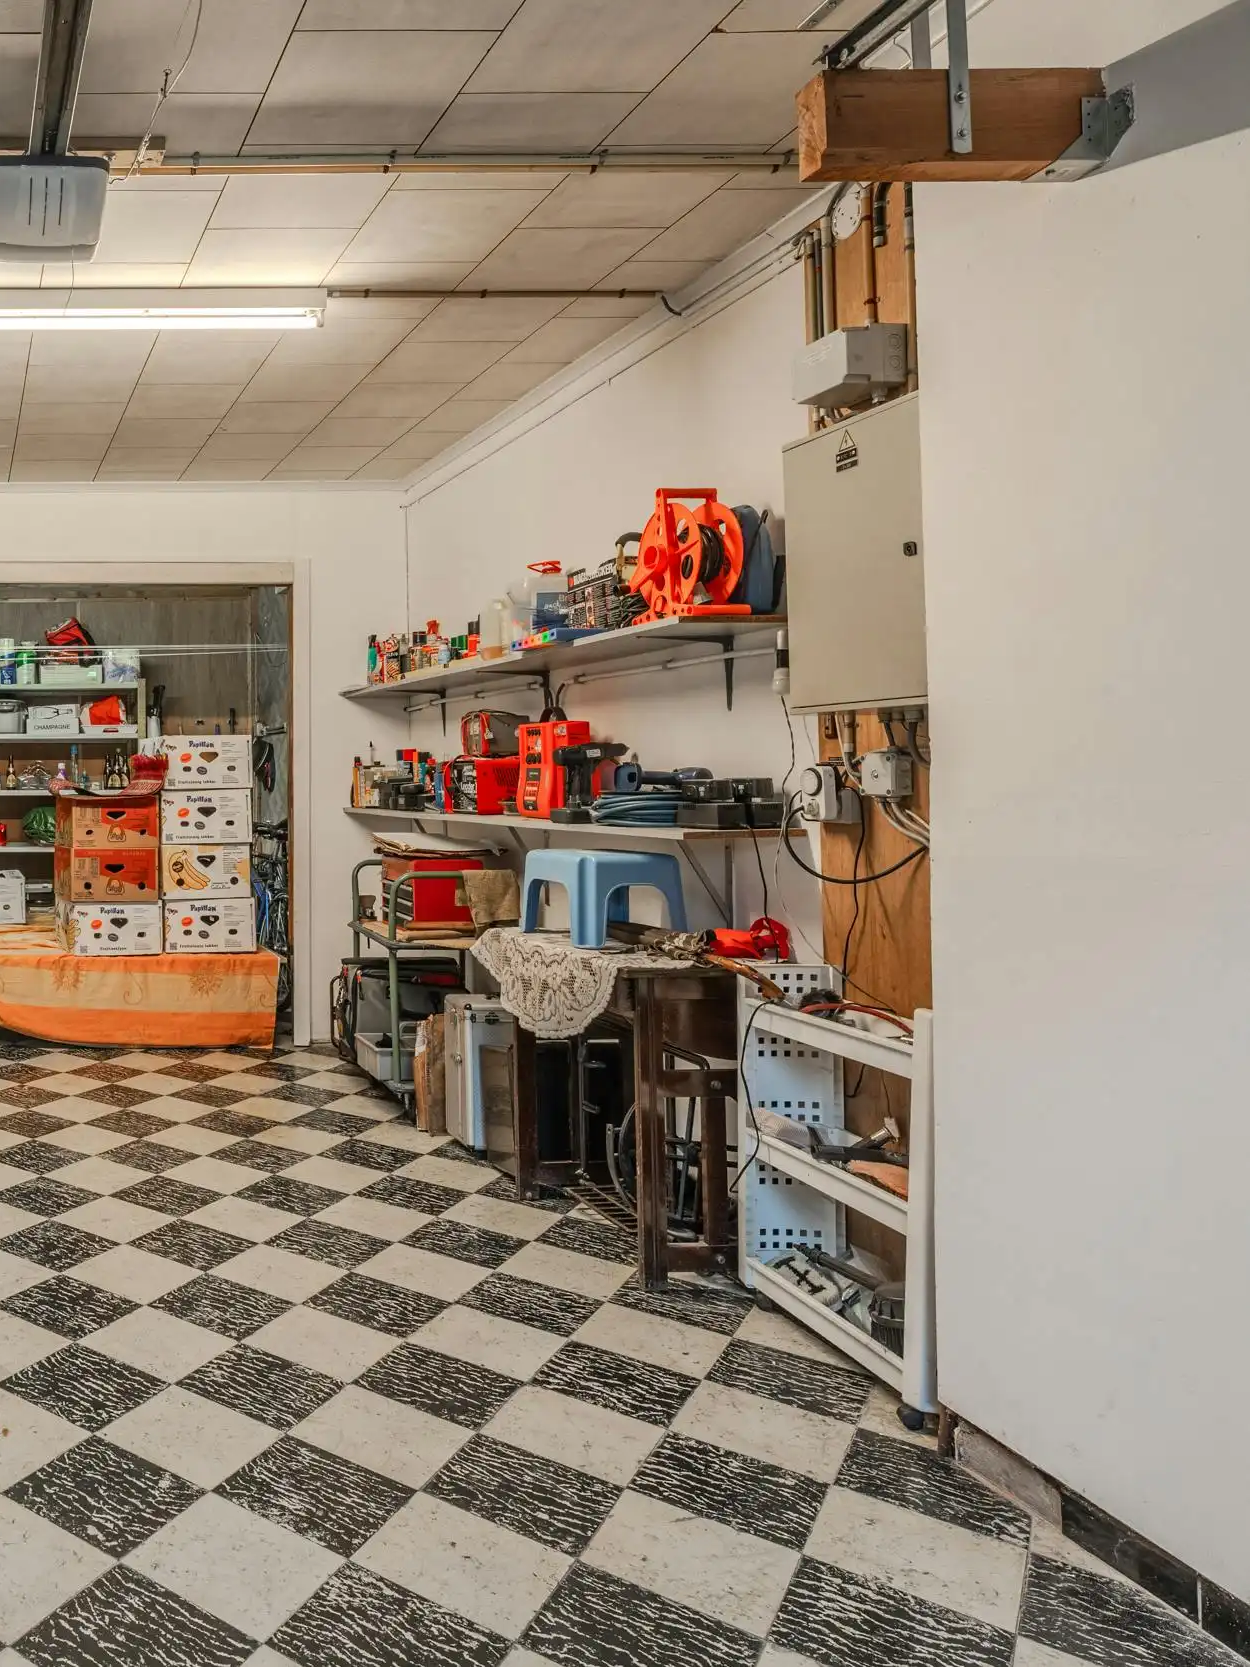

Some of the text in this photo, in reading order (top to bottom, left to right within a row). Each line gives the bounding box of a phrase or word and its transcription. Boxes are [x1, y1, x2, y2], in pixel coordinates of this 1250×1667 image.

[188, 740, 215, 749] Papillon
[186, 795, 213, 803] Papillon
[100, 907, 125, 915] Papillon
[190, 904, 217, 912] Papillon
